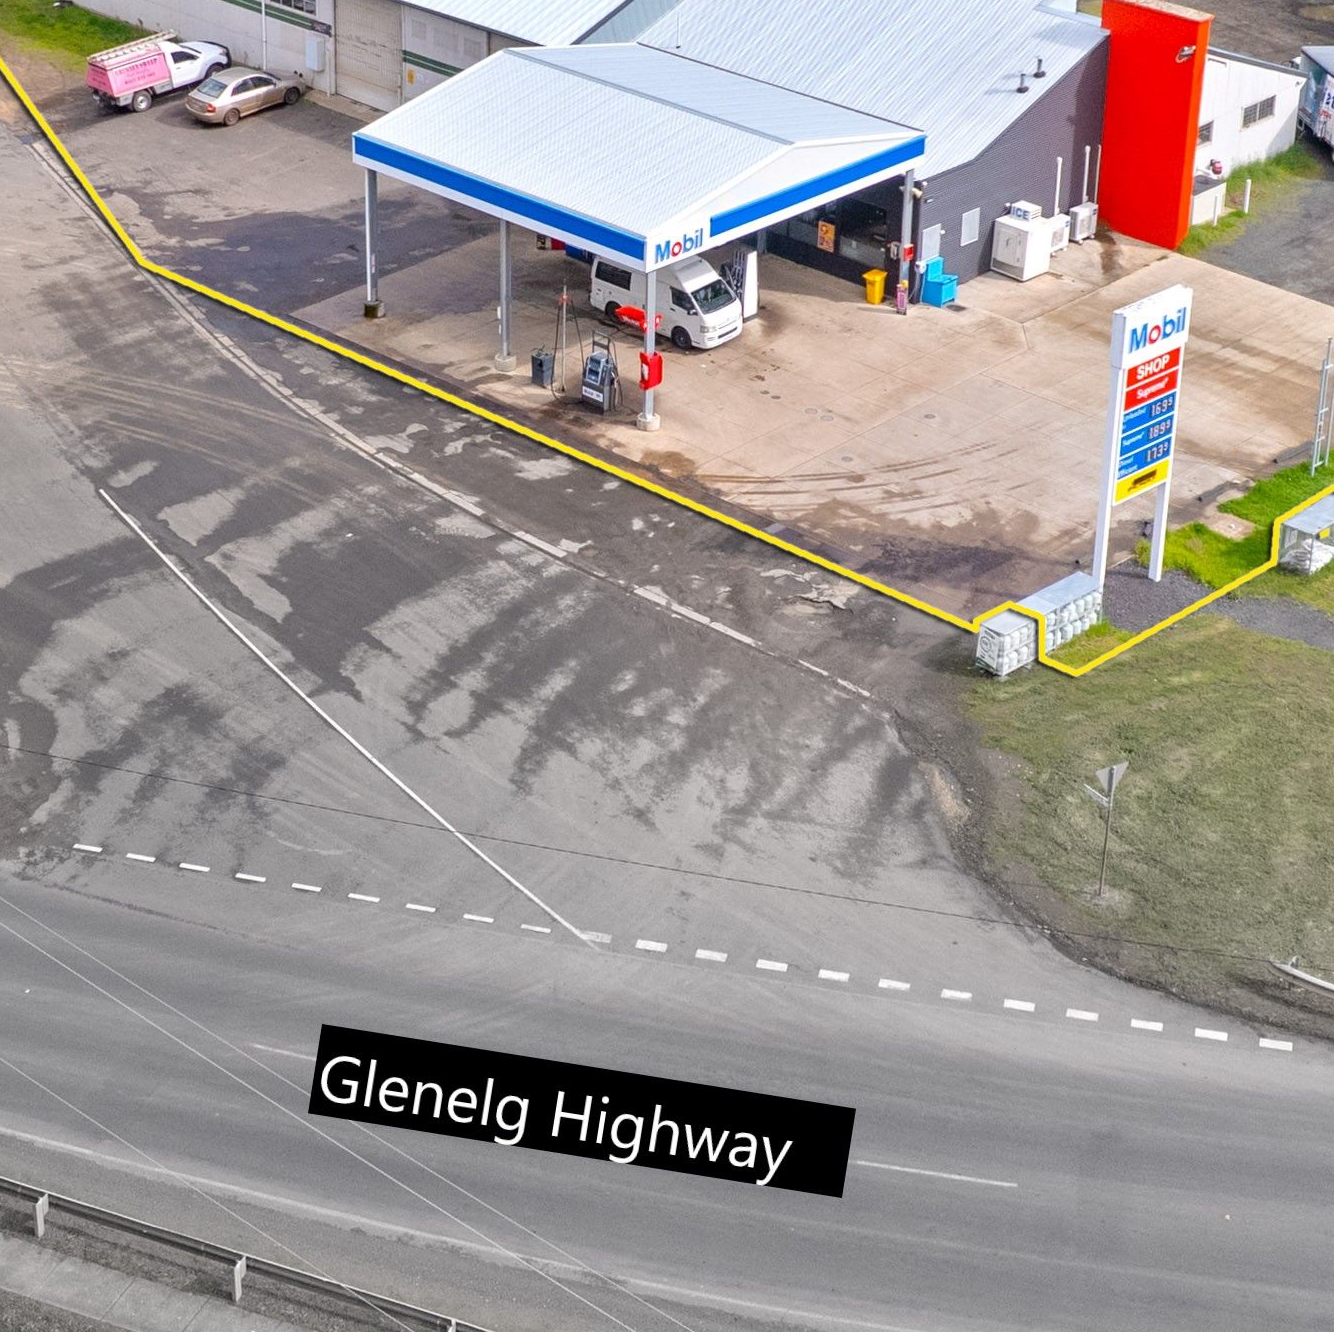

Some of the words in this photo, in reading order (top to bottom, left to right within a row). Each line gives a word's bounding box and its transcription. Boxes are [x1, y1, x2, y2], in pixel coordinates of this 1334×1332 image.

[1012, 206, 1029, 220] ICE
[655, 228, 703, 263] Mobil
[1128, 307, 1187, 354] Mobil
[1136, 354, 1170, 380] SHOP
